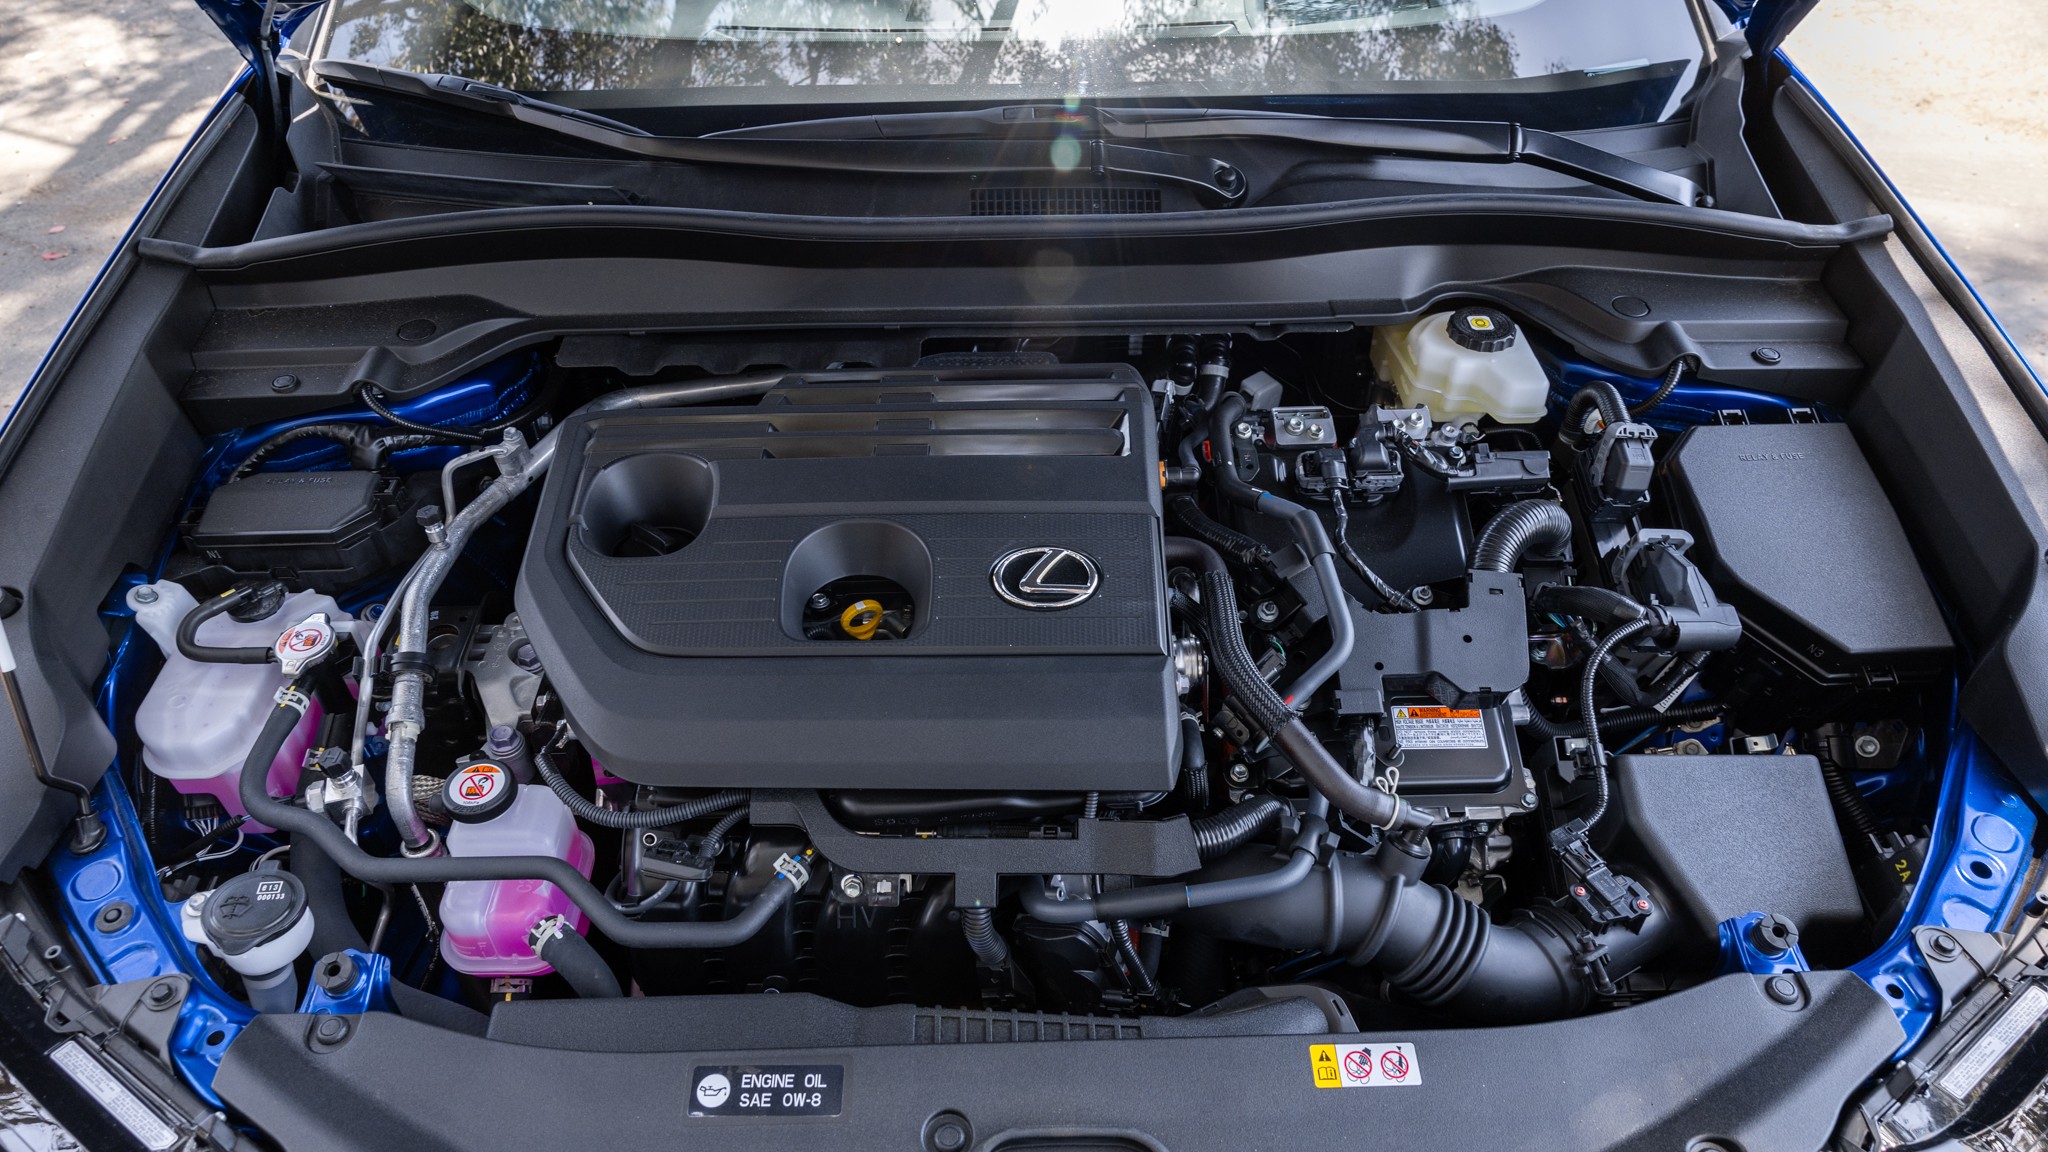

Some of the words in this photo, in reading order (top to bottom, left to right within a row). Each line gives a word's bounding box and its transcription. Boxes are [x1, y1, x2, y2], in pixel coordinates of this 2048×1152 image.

[1779, 452, 1805, 460] FUSE
[1807, 643, 1825, 658] N3
[1894, 859, 1911, 882] 2A
[256, 893, 285, 901] 000133
[837, 903, 877, 928] HV
[741, 1074, 795, 1088] ENGINE
[804, 1073, 827, 1088] OIL
[739, 1093, 772, 1107] SAE
[782, 1092, 821, 1107] 0W-8
